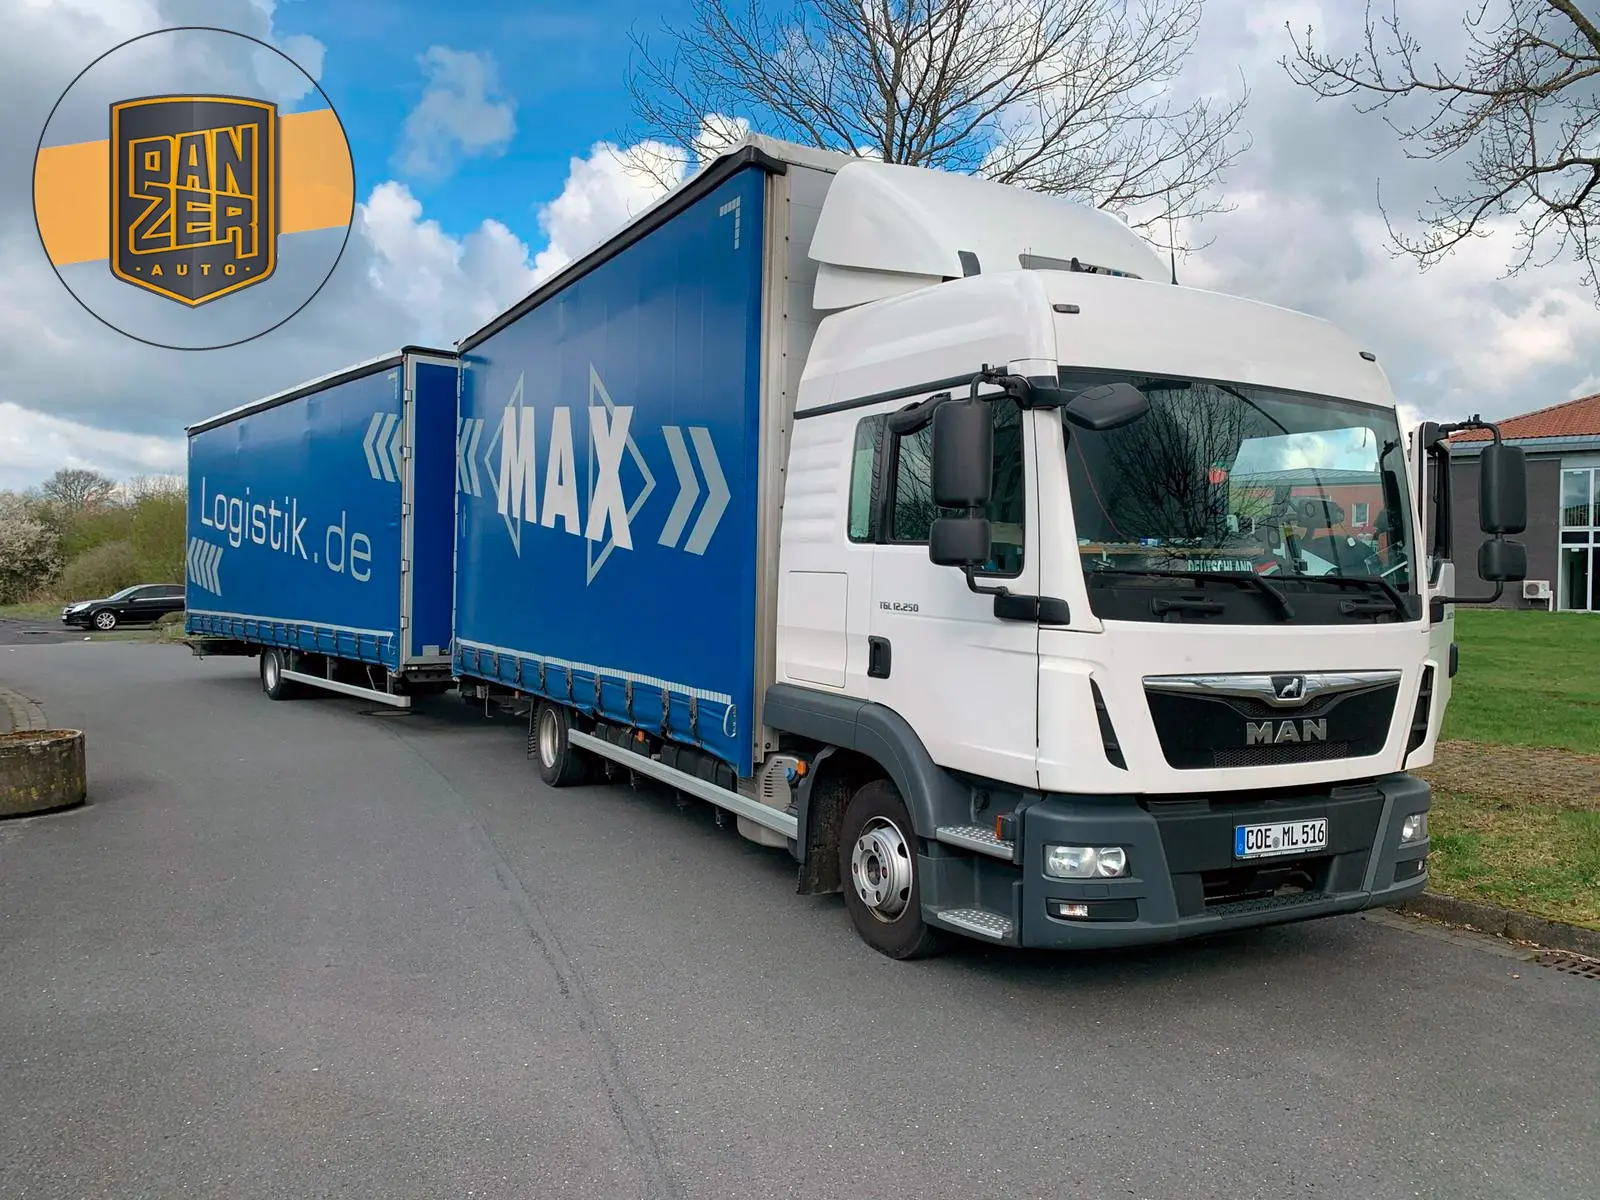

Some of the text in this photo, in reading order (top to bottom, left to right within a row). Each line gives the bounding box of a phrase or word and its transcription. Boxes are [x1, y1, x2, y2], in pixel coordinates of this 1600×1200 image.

[497, 405, 634, 550] MAX
[880, 601, 919, 612] TGL 12.250
[1246, 718, 1327, 745] MAN
[1246, 823, 1324, 850] COE ML 516
